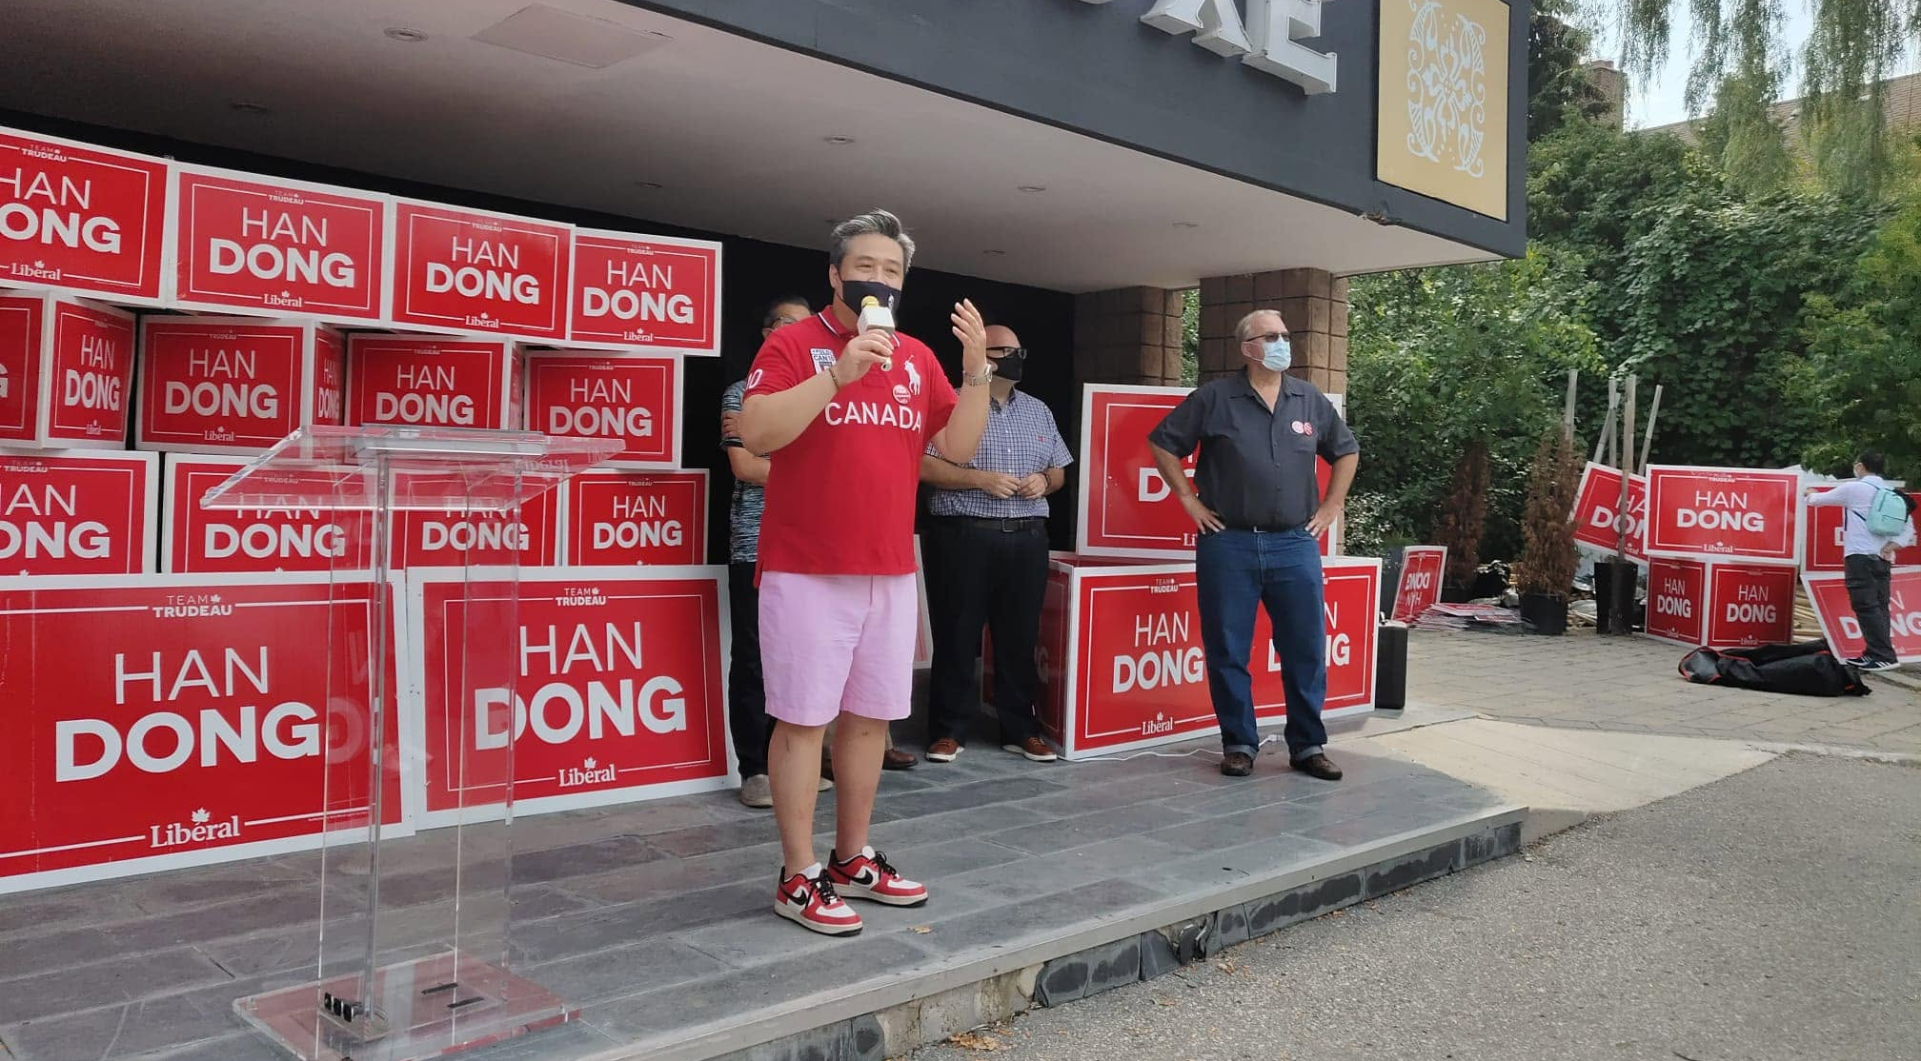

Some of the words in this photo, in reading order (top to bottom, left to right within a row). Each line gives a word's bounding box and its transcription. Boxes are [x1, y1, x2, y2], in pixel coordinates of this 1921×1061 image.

[21, 149, 67, 162] TRUDEAU
[268, 195, 304, 205] TRUDEAU
[242, 207, 327, 247] HAN
[210, 238, 355, 288] DONG
[451, 236, 518, 270] HAN
[426, 262, 540, 305] DONG
[607, 260, 671, 290] HAN
[583, 286, 694, 325] DONG
[81, 334, 115, 371] HAN
[189, 349, 257, 380] HAN
[65, 368, 120, 411] DONG
[397, 364, 455, 391] HAN
[570, 378, 631, 404] HAN
[165, 381, 278, 420] DONG
[375, 391, 474, 425] DONG
[549, 405, 652, 437] DONG
[825, 401, 922, 433] CANADA
[0, 483, 76, 517] AN
[613, 495, 665, 518] HAN
[1695, 490, 1748, 509] HAN
[422, 521, 529, 550] DONG
[593, 521, 682, 550] DONG
[1677, 508, 1765, 532] DONG
[204, 523, 345, 559] DONG
[167, 595, 208, 605] TEAM
[555, 596, 606, 606] TRUDEAU
[564, 588, 590, 596] TEAM
[1664, 577, 1686, 595] HAN
[1738, 584, 1769, 602] HAN
[152, 605, 232, 617] TRUDEAU
[1657, 594, 1692, 618] DONG
[1726, 603, 1777, 624] DONG
[1134, 611, 1189, 647] HAN
[1838, 611, 1921, 640] DNG
[519, 621, 642, 676] HAN
[115, 646, 269, 704] HAN
[1112, 646, 1204, 693] DONG
[474, 676, 686, 750] DONG
[55, 701, 320, 783] DONG
